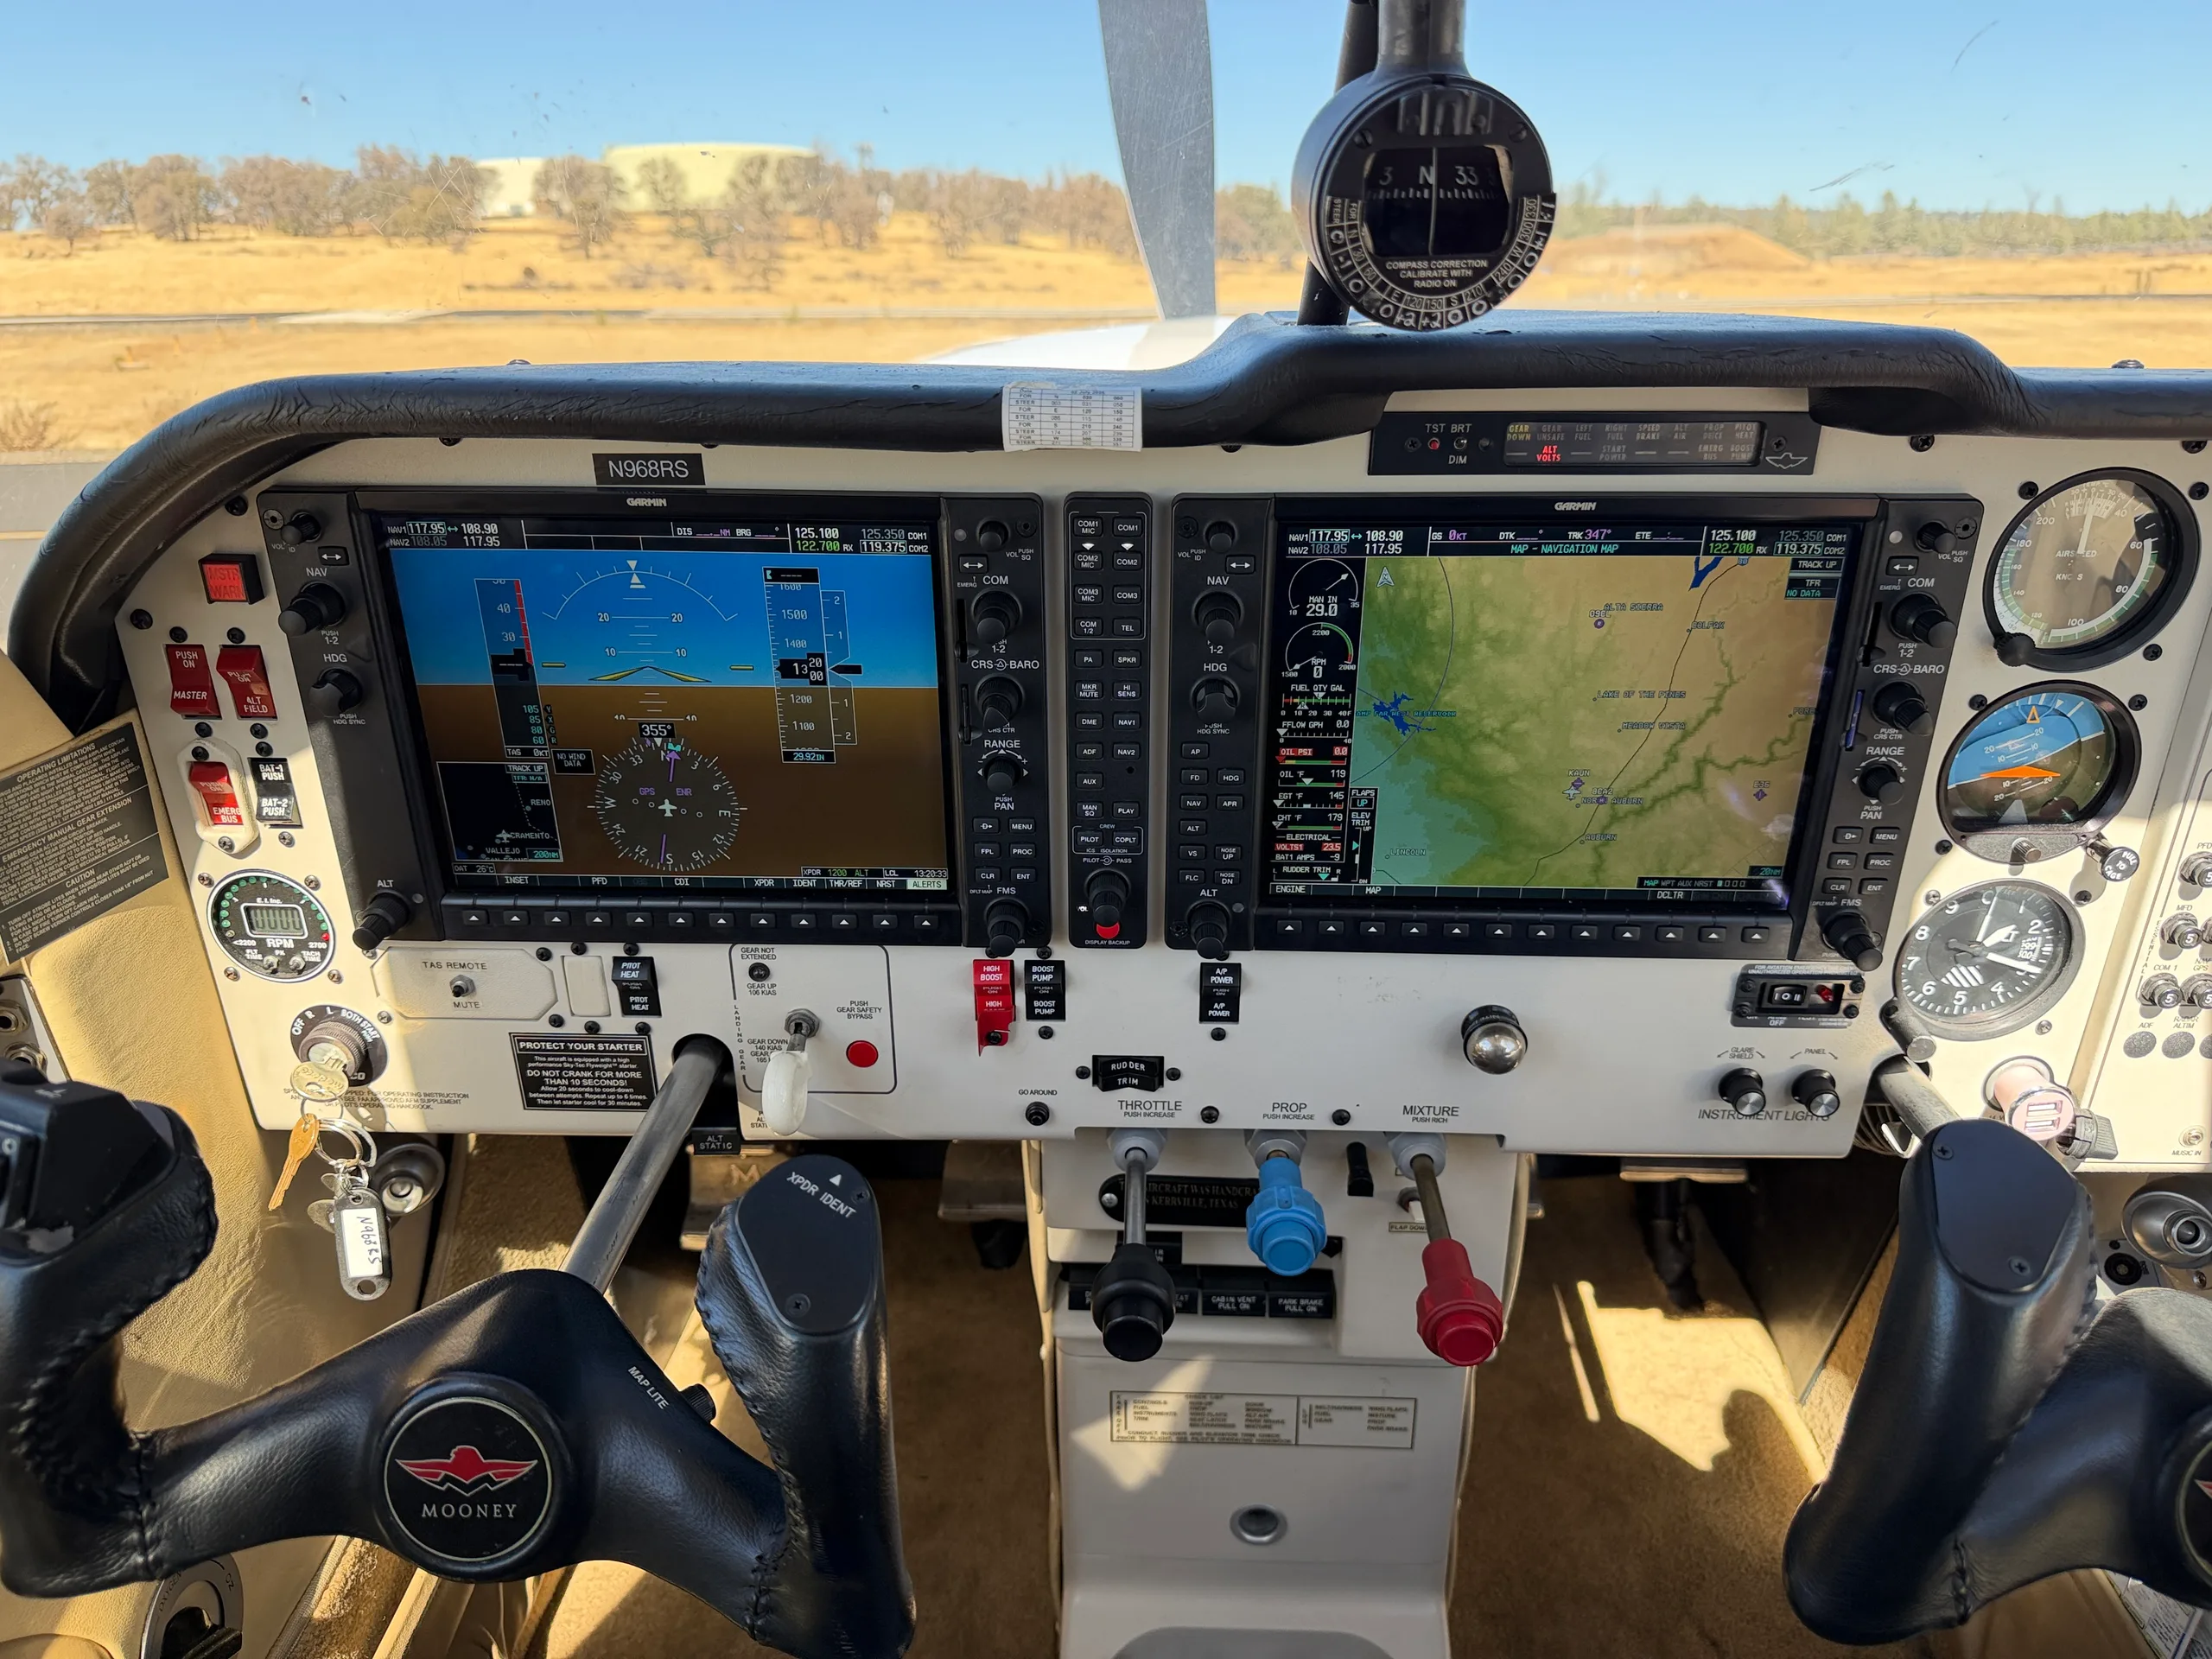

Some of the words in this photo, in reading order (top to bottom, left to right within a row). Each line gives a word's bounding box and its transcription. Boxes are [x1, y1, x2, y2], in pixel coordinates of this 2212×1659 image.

[1455, 166, 1478, 185] 33
[1400, 270, 1448, 278] CALIBRATE
[1451, 424, 1471, 433] BRT
[1448, 455, 1467, 464] DIM
[608, 461, 689, 478] N968RS
[388, 525, 406, 534] NAV1
[408, 523, 444, 534] 117.95
[461, 524, 498, 534] 108.90
[795, 528, 838, 538] 125.100
[861, 530, 905, 539] 125.350
[1311, 531, 1348, 541] 117.95
[1365, 531, 1403, 541] 108.90
[1711, 531, 1756, 540] 125.100
[463, 536, 499, 546] 117.95
[797, 541, 840, 550] 122.700
[862, 542, 906, 552] 119.375
[1511, 544, 1528, 553] MAP
[1541, 544, 1598, 553] NAVIGATION
[1601, 544, 1618, 553] MAP
[1708, 543, 1753, 554] 122.700
[1777, 544, 1821, 555] 119.375
[1207, 576, 1230, 585] NAV
[1908, 578, 1935, 587] COM
[782, 610, 807, 620] 1500
[1306, 604, 1338, 616] 29.0
[183, 659, 195, 668] ON
[324, 654, 347, 663] HDG
[971, 660, 993, 669] CRS
[1010, 660, 1039, 669] BARO
[174, 691, 207, 700] MASTER
[246, 696, 260, 705] ALT
[244, 704, 268, 714] FIELD
[984, 740, 1020, 748] RANGE
[259, 764, 283, 772] BAT-1
[261, 798, 288, 808] BAT-2
[263, 807, 285, 817] PUSH
[2122, 851, 2137, 866] PULL
[2116, 861, 2126, 870] TO
[2104, 866, 2121, 880] CAGE
[267, 938, 294, 948] RPM
[446, 962, 487, 970] REMOTE
[1922, 981, 1936, 995] 6
[1954, 991, 1967, 1005] 5
[454, 1001, 480, 1009] MUTE
[1118, 1100, 1182, 1110] THROTTLE
[1272, 1103, 1307, 1113] PROP
[1403, 1105, 1459, 1116] MIXTURE
[787, 1172, 819, 1196] XPDR
[819, 1192, 856, 1218] IDENT
[628, 1365, 650, 1387] MAP
[646, 1386, 670, 1410] LITE
[422, 1503, 517, 1517] MOONEY
